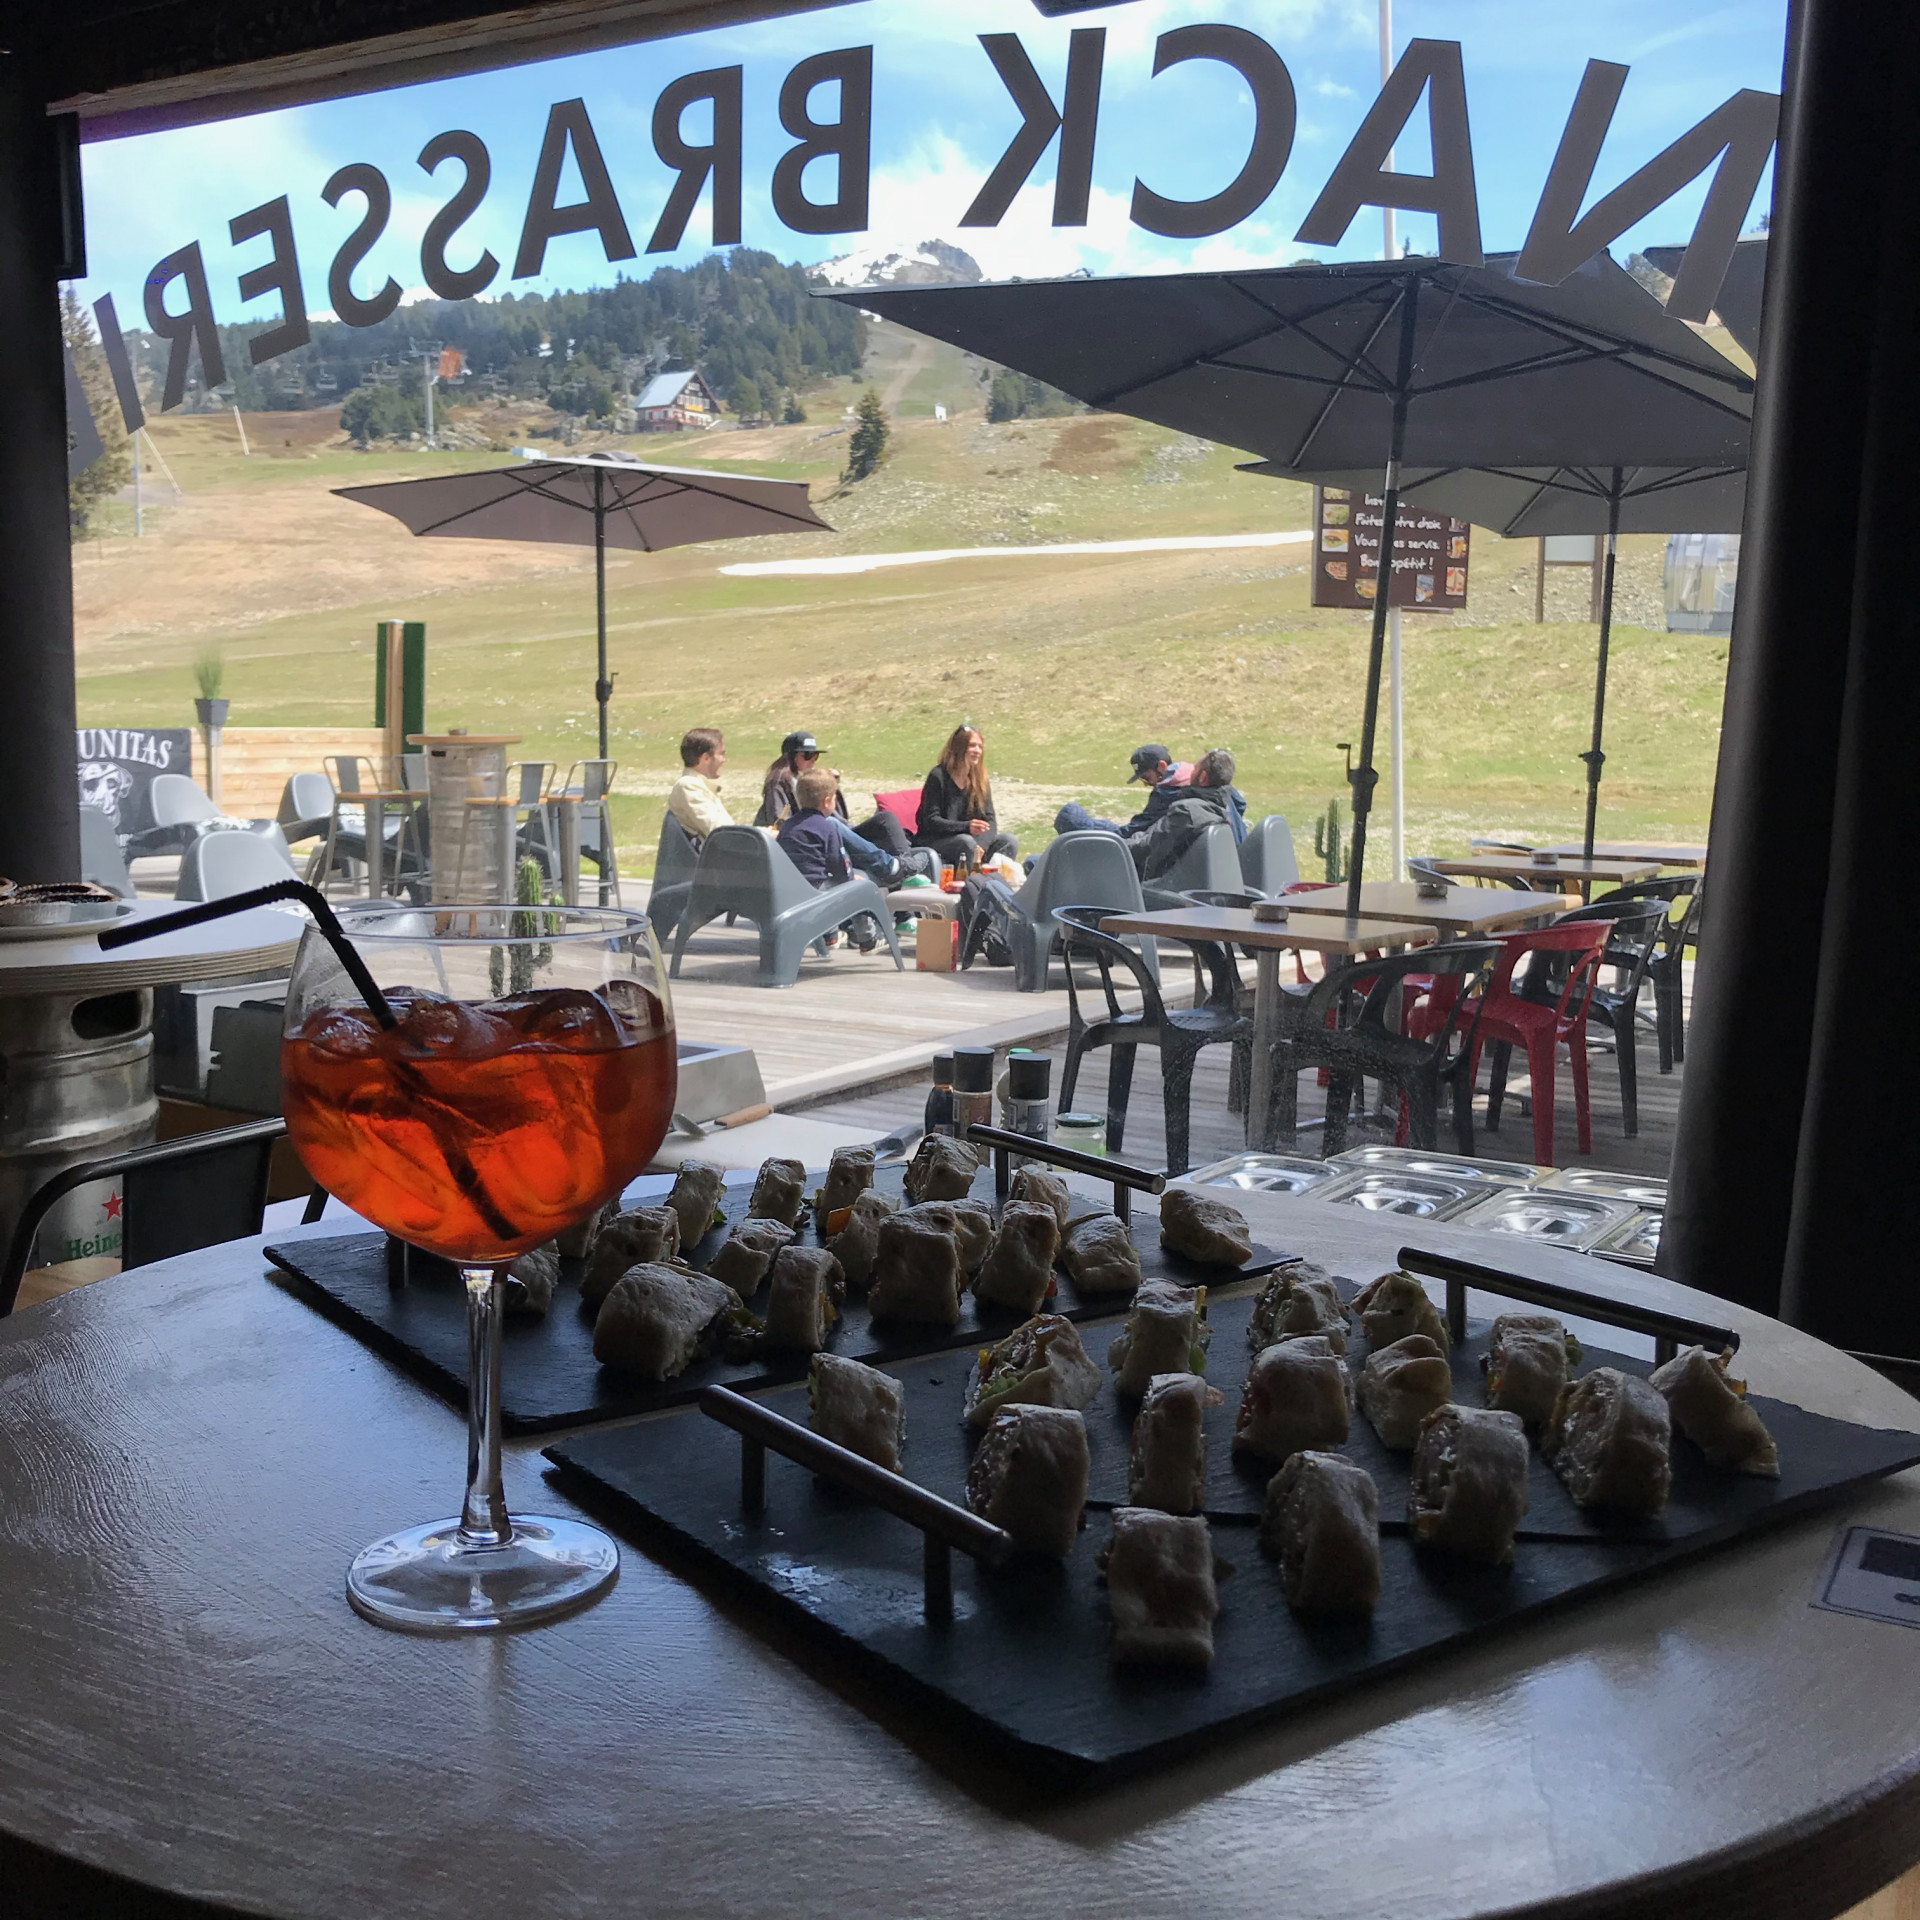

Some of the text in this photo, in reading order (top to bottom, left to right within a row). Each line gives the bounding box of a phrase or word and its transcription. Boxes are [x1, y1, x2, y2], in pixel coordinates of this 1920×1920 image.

[1417, 516, 1441, 529] choix
[1354, 533, 1378, 547] Vous
[1360, 553, 1380, 568] Bon
[76, 728, 172, 769] UNITAS
